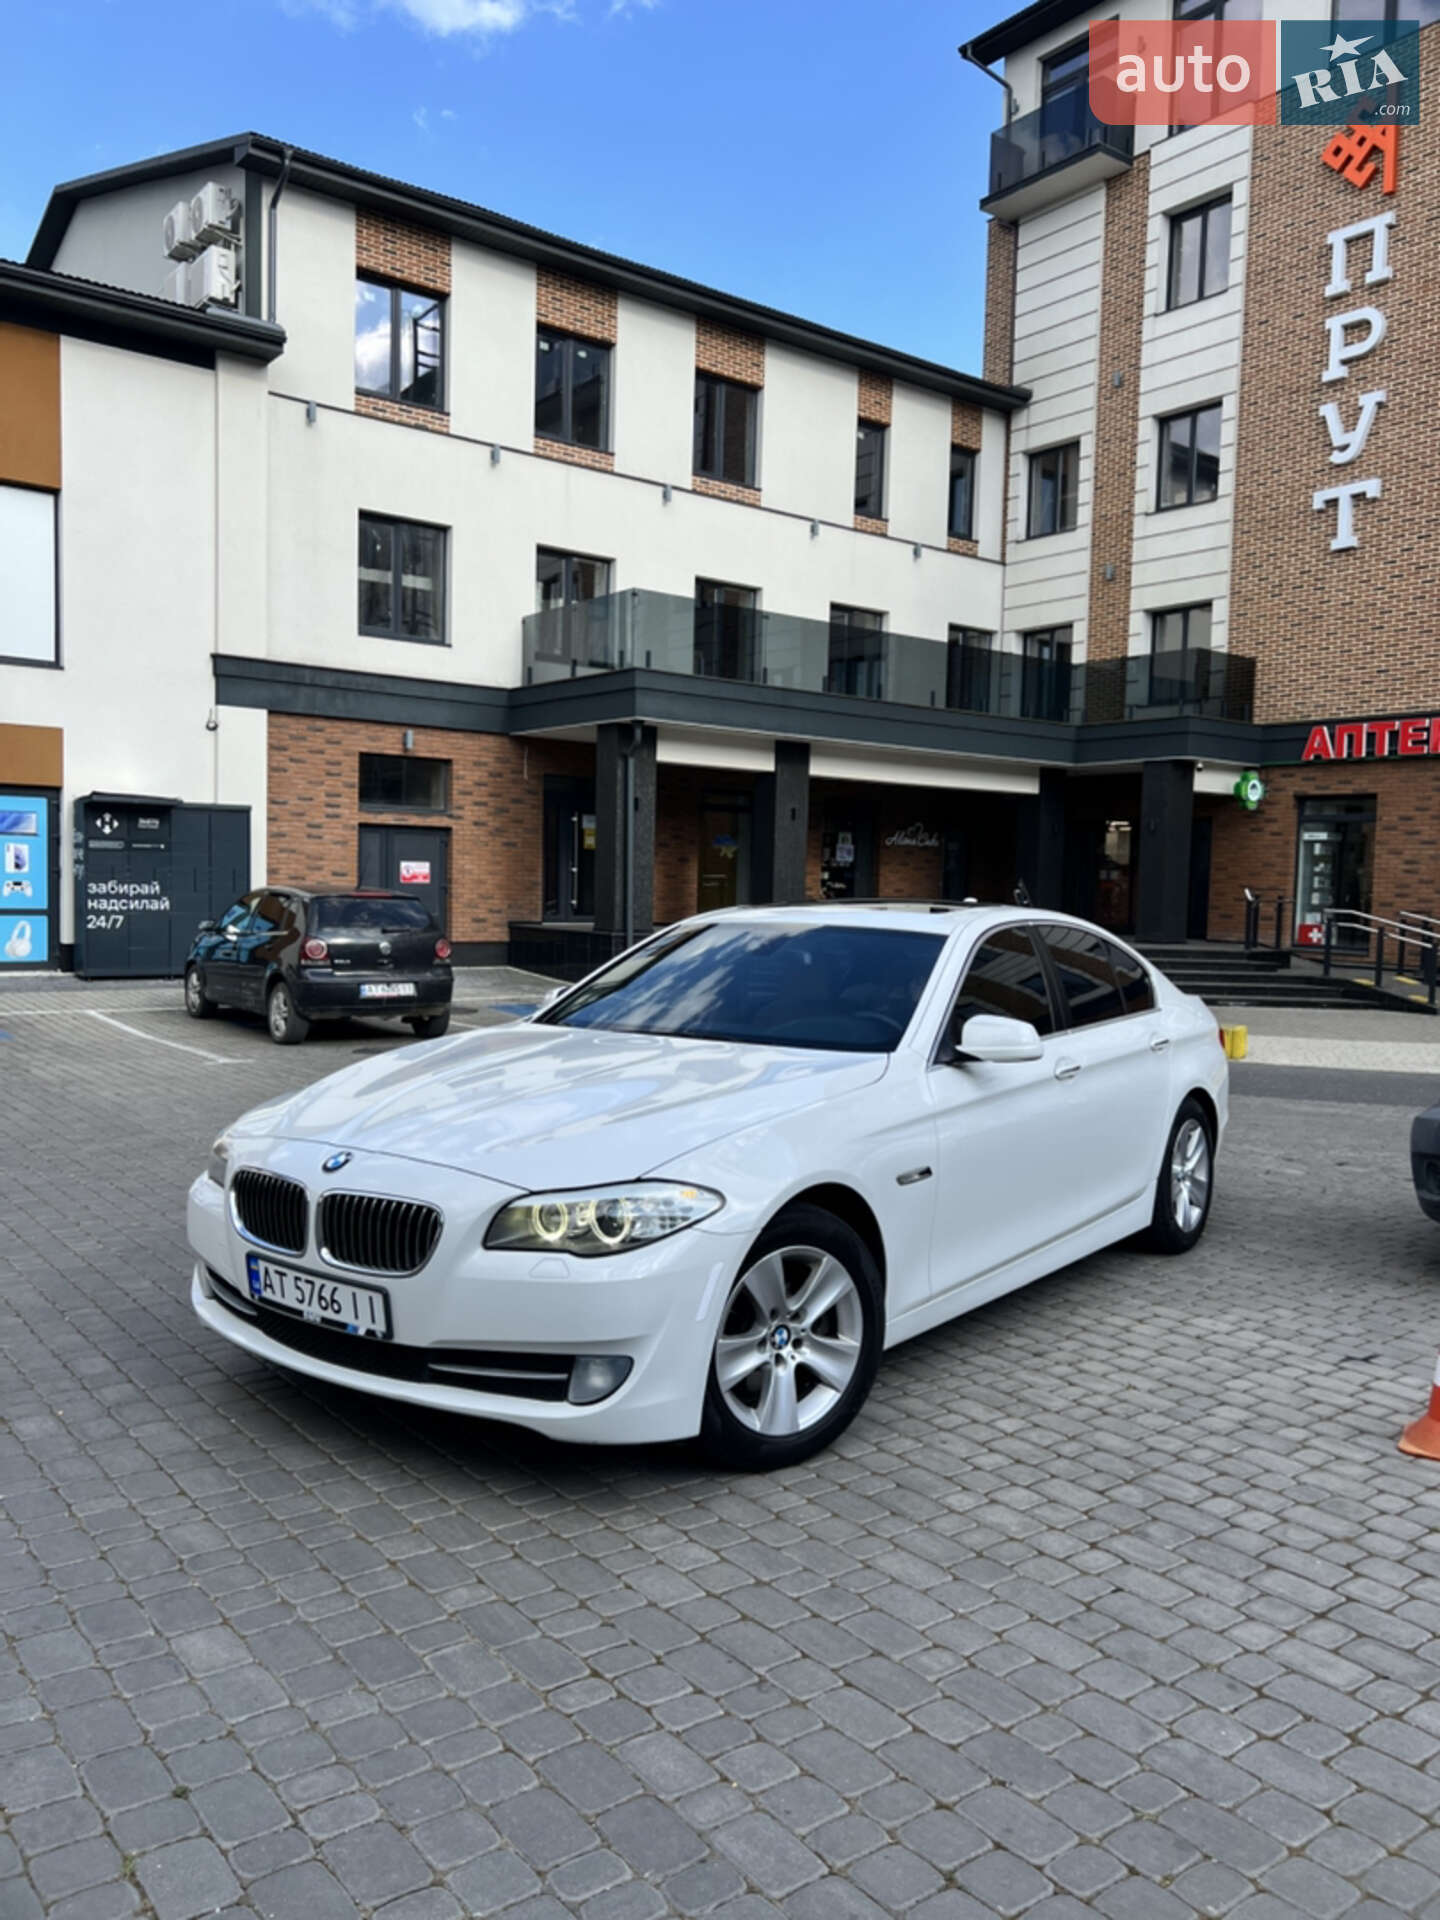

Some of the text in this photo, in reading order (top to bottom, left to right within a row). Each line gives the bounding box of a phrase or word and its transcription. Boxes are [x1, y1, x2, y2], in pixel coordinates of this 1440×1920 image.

[1312, 211, 1397, 550] ПРУТ
[87, 880, 160, 896] забирай
[87, 897, 170, 911] надсилай
[86, 914, 124, 929] 24/7
[263, 1266, 287, 1299] AT
[294, 1275, 342, 1315] 5766
